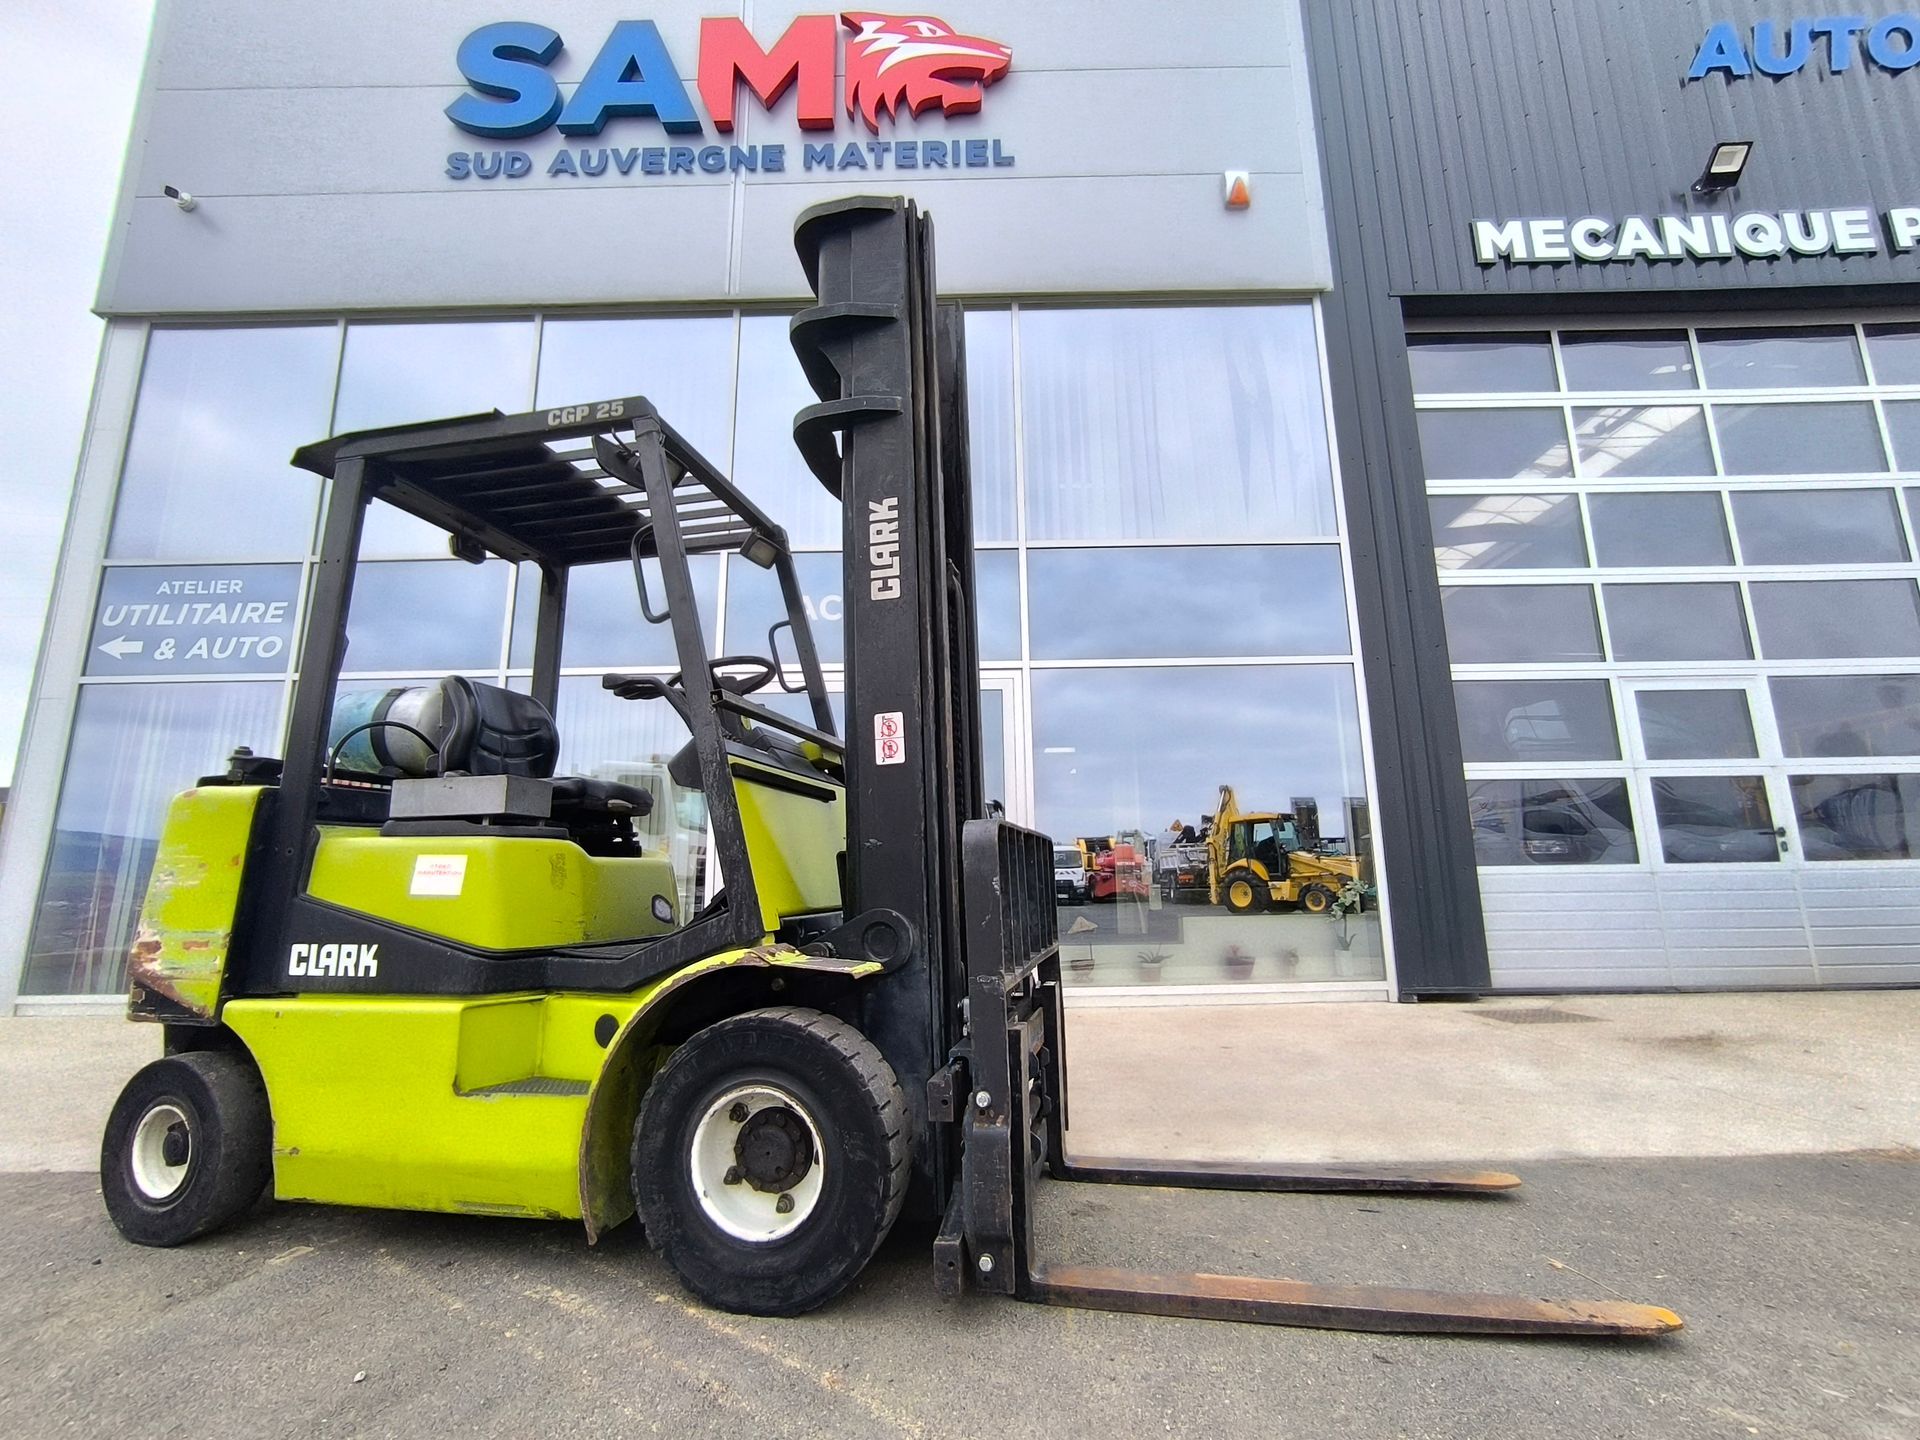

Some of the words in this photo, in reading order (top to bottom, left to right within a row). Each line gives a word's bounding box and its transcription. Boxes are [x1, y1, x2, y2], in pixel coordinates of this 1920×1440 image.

[1688, 12, 1920, 78] AUTO
[444, 15, 836, 137] SAM
[446, 151, 531, 179] SUD
[548, 144, 785, 176] AUVERGNE
[803, 139, 1016, 171] MATERIEL
[1472, 210, 1878, 264] MECANIQUE
[548, 405, 590, 426] CGP
[596, 401, 624, 420] 25
[868, 496, 901, 601] CLARK
[156, 580, 243, 595] ATELIER
[102, 601, 289, 627] UTILITAIRE
[153, 638, 177, 660] &
[184, 635, 283, 660] AUTO
[288, 943, 379, 978] CLARK
